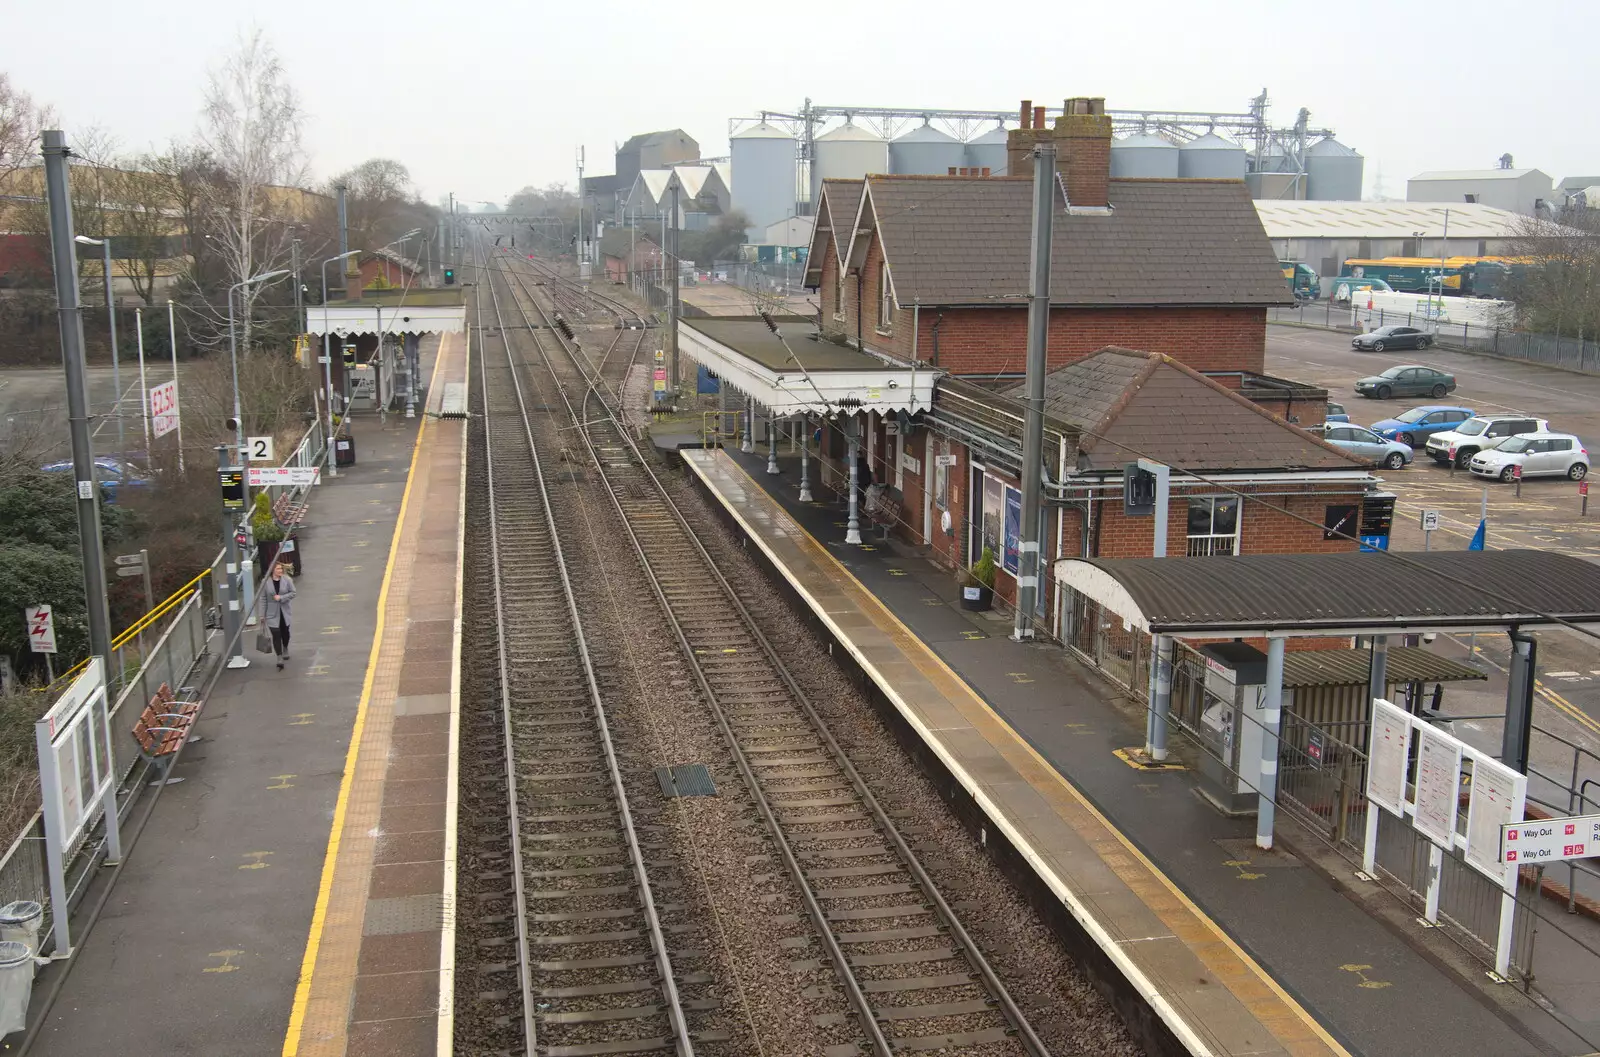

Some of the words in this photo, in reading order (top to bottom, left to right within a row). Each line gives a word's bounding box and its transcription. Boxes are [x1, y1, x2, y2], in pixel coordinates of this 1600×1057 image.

[254, 440, 267, 457] 2
[1524, 829, 1539, 838] Way
[1540, 828, 1552, 836] Out
[1523, 850, 1538, 859] Way
[1538, 849, 1551, 857] Out
